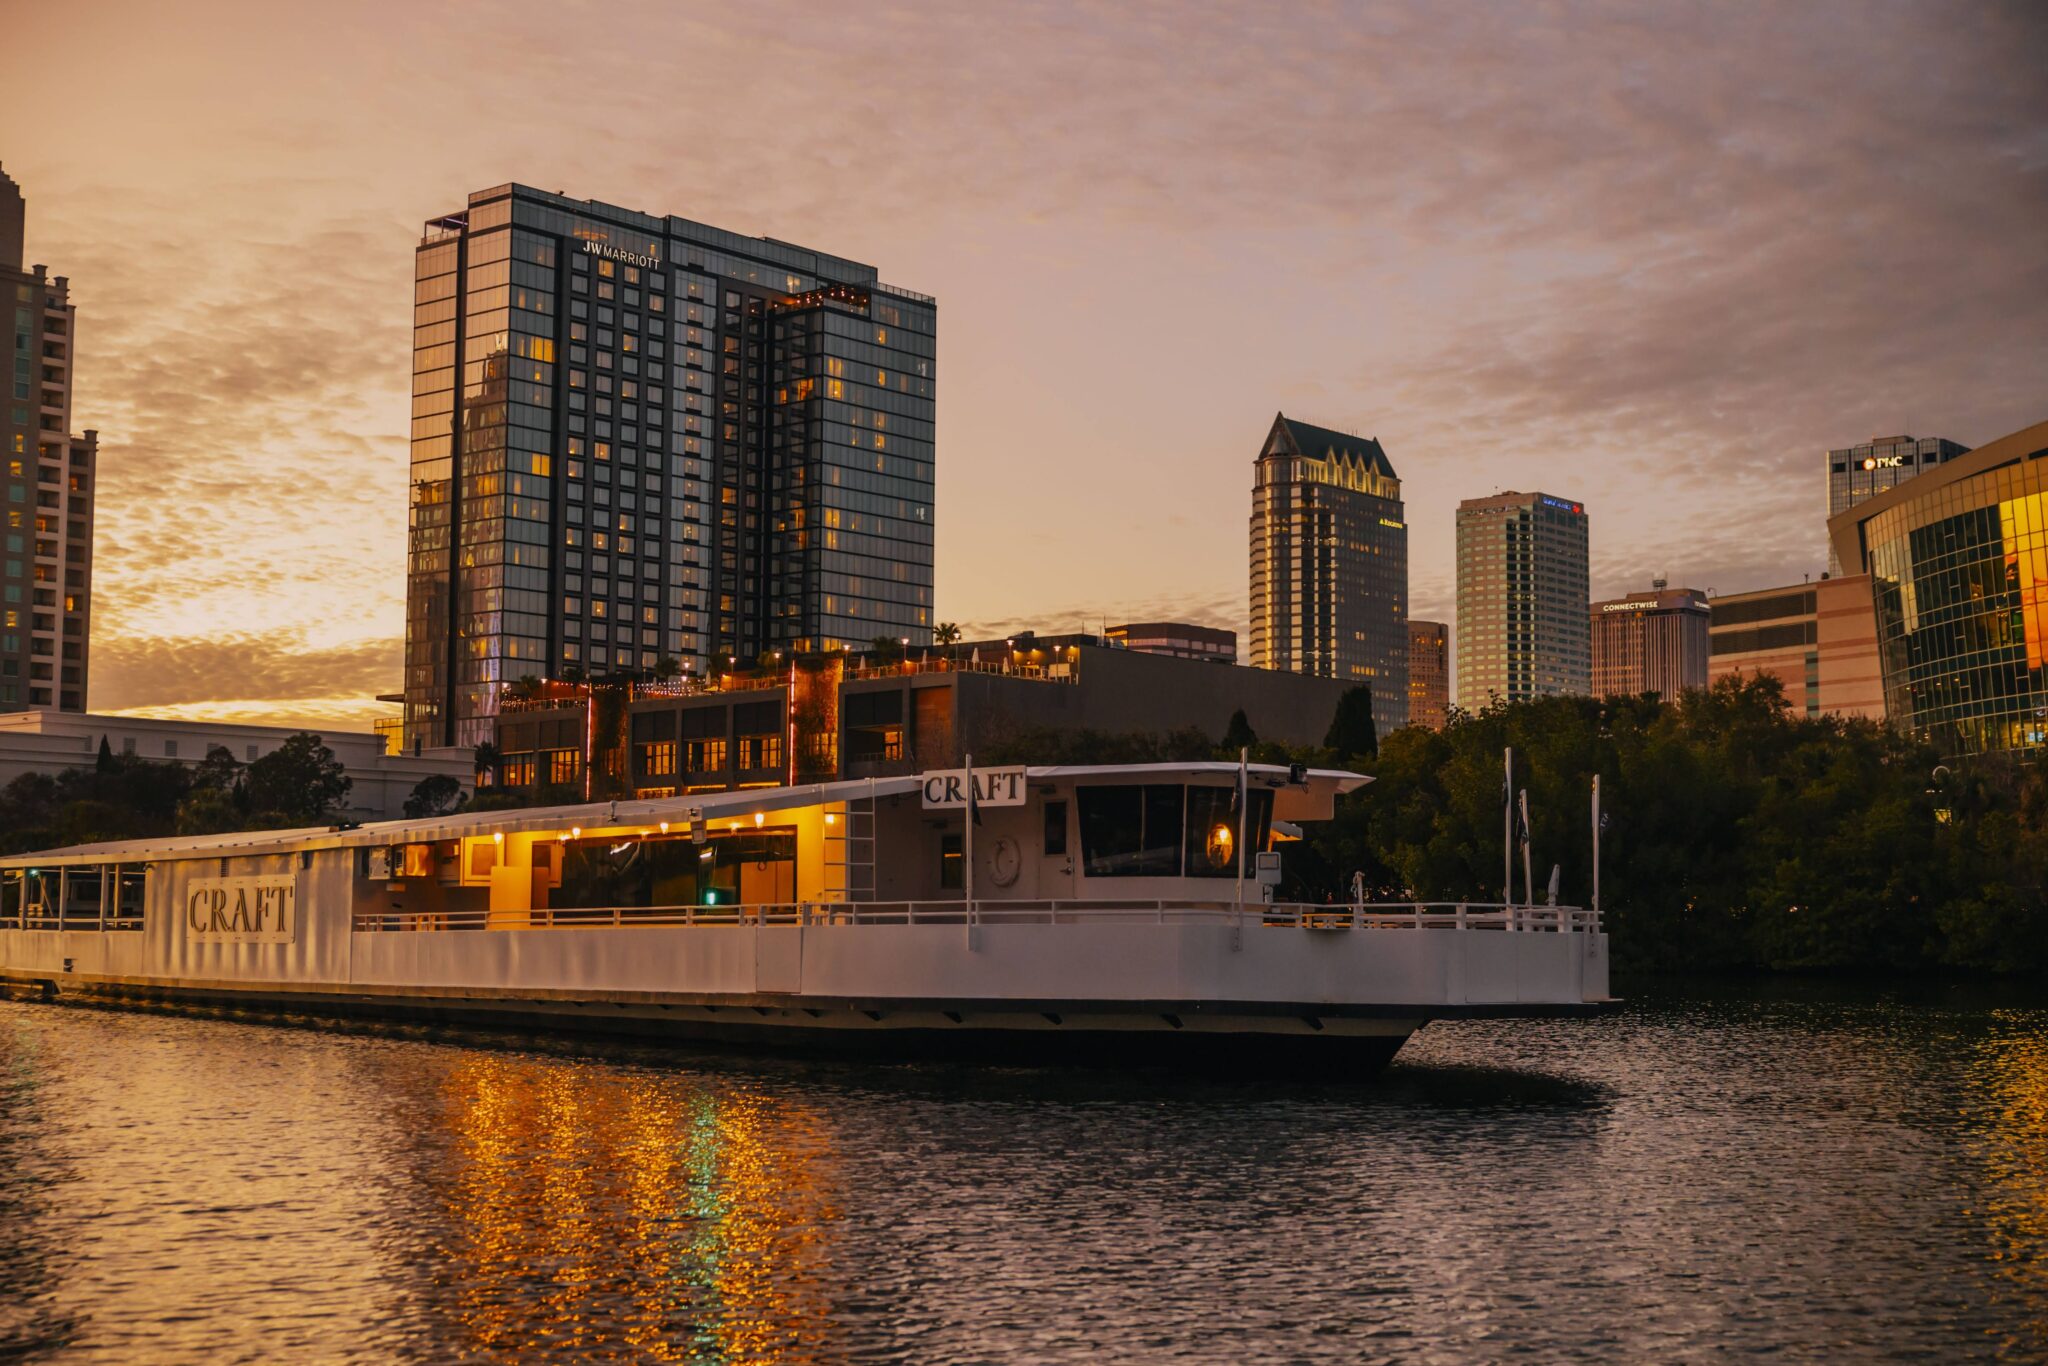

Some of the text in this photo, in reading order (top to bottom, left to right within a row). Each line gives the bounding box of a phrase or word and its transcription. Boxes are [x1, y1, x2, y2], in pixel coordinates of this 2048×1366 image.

[583, 241, 660, 270] JW MARRIOTT
[1876, 456, 1903, 468] PNC
[1603, 601, 1658, 612] CONNECTWISE
[924, 771, 1024, 803] CRAFT
[189, 886, 293, 933] CRAFT
